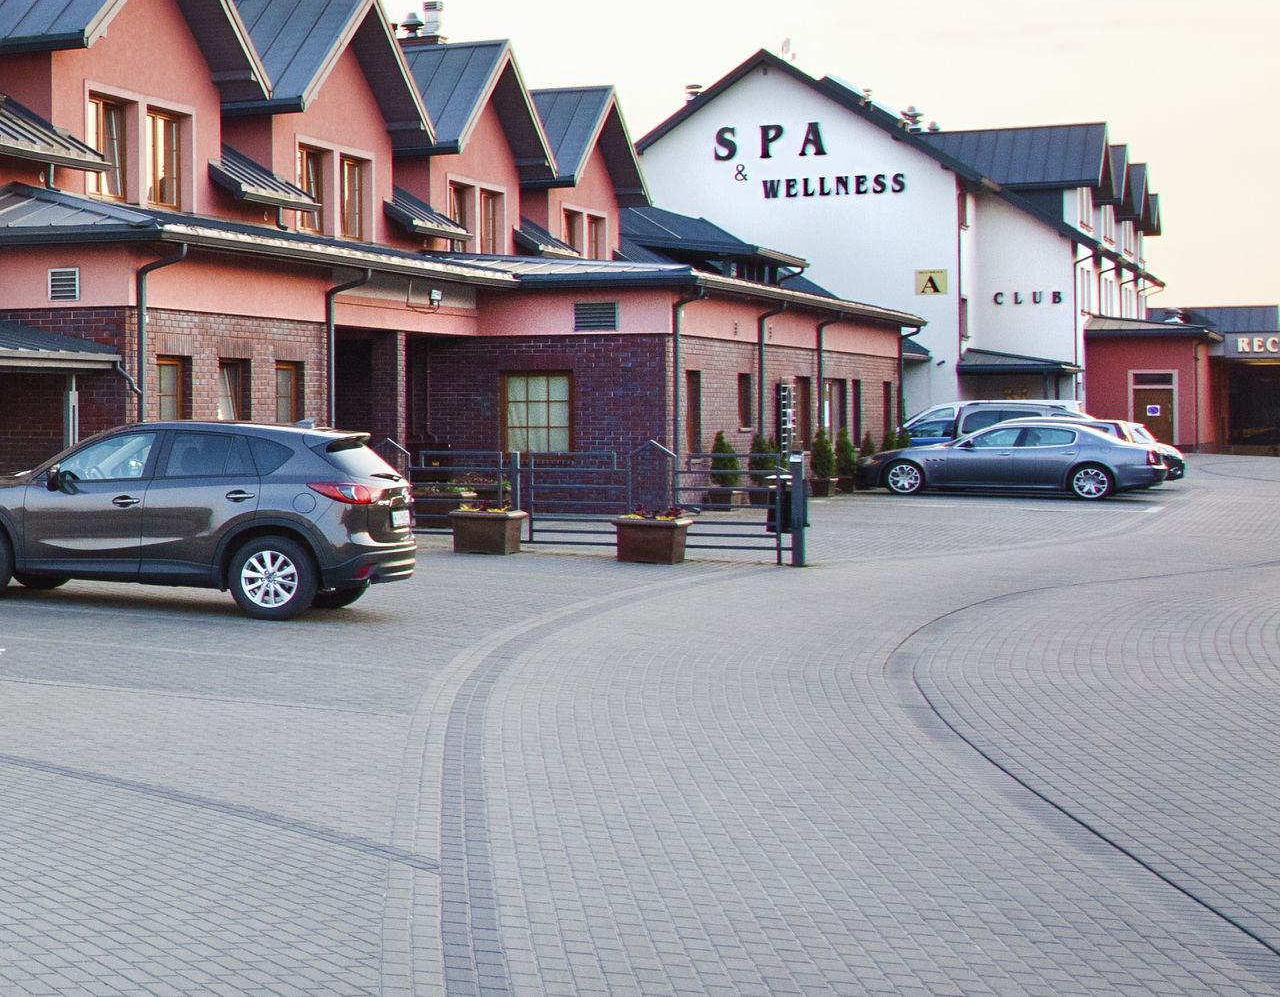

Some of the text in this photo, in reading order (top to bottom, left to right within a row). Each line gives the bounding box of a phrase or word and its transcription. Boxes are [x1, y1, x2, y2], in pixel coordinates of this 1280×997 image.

[714, 121, 827, 161] SPA
[734, 163, 748, 181] &
[762, 173, 906, 198] WELLNESS
[920, 275, 941, 293] A
[993, 290, 1062, 305] CLUB
